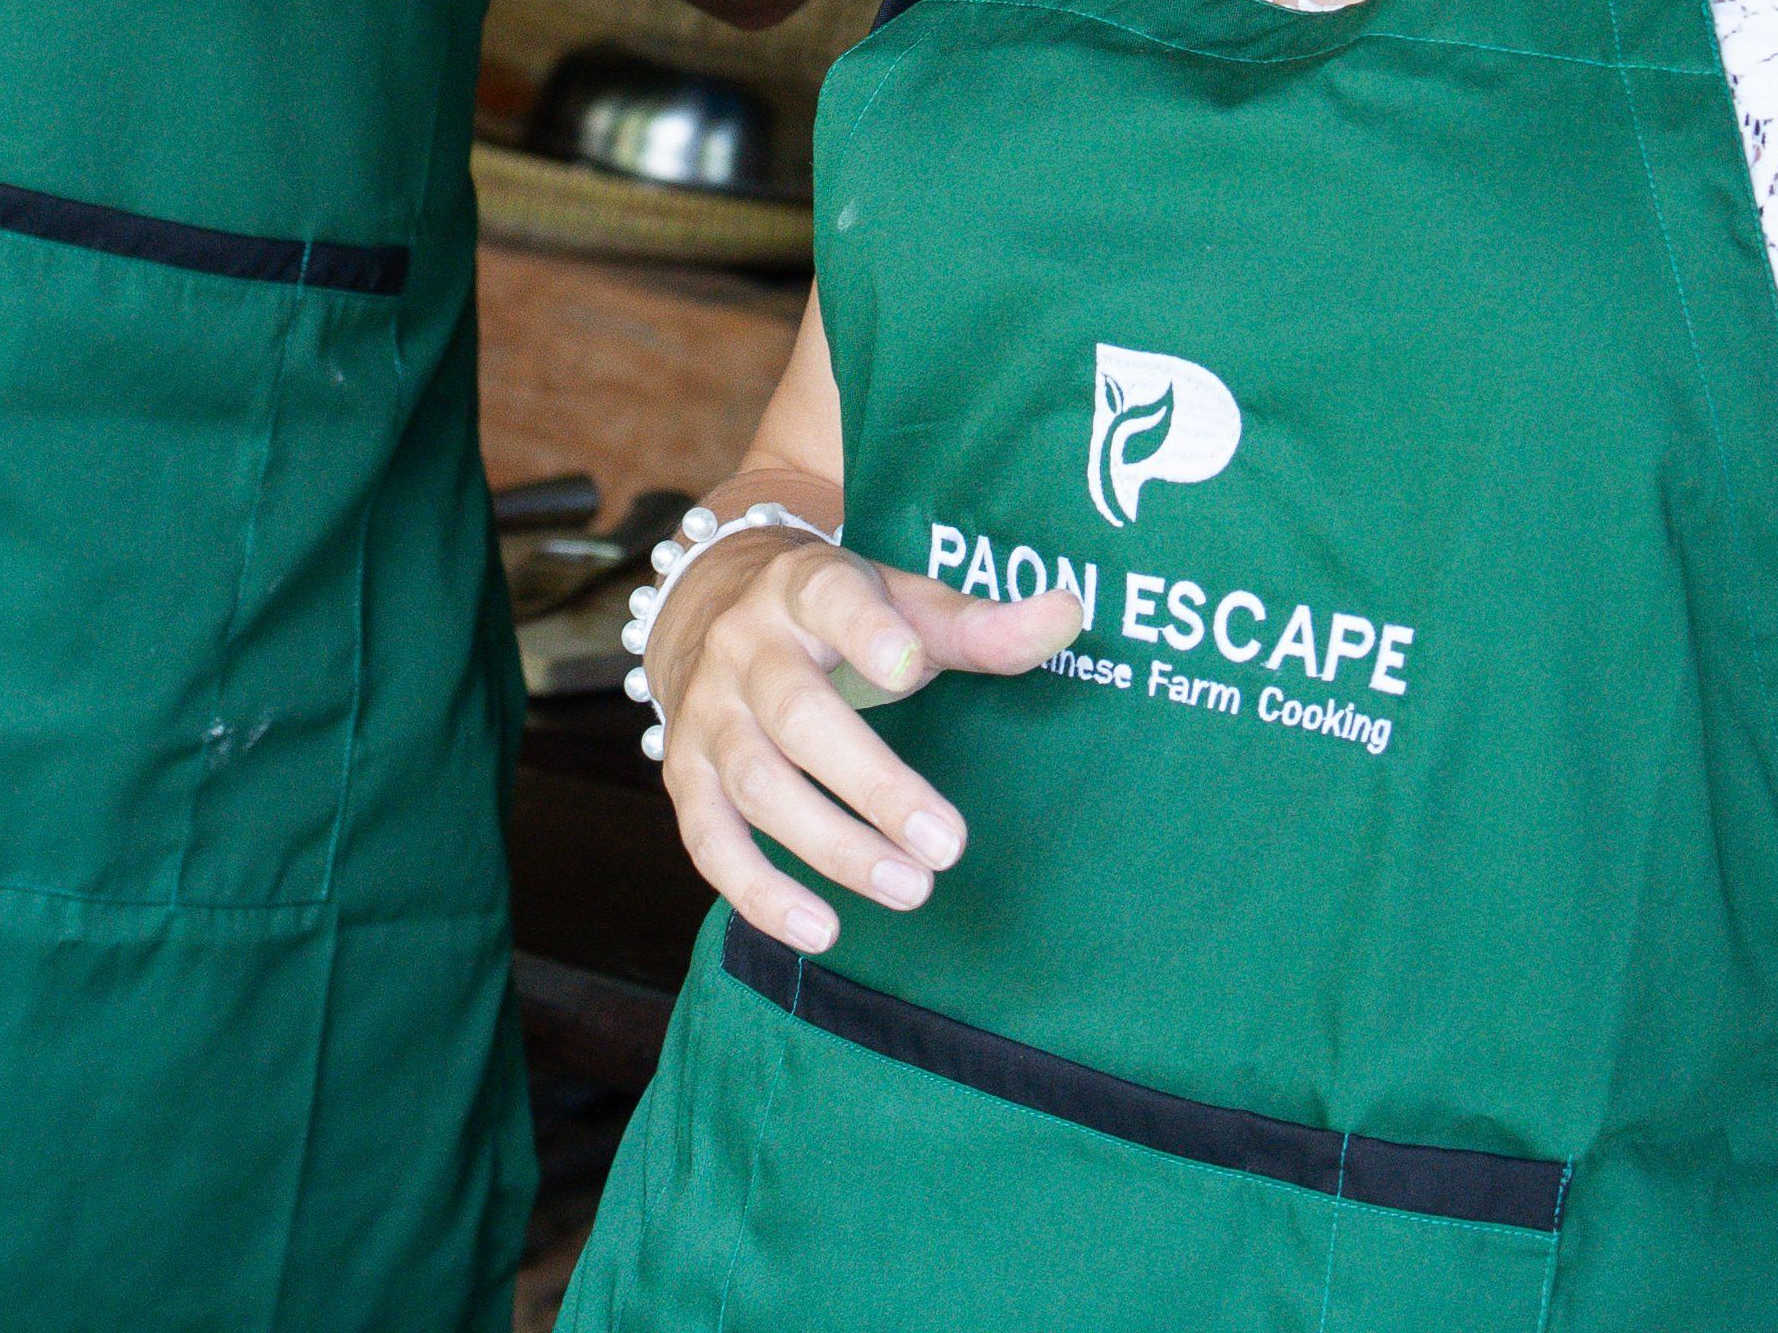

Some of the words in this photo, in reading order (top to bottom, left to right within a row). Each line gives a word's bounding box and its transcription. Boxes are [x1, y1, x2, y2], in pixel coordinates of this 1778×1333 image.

[927, 522, 1097, 632] PAON
[1121, 572, 1415, 696] ESCAPE
[1147, 659, 1241, 715] Farm
[1257, 685, 1392, 755] Cooking
